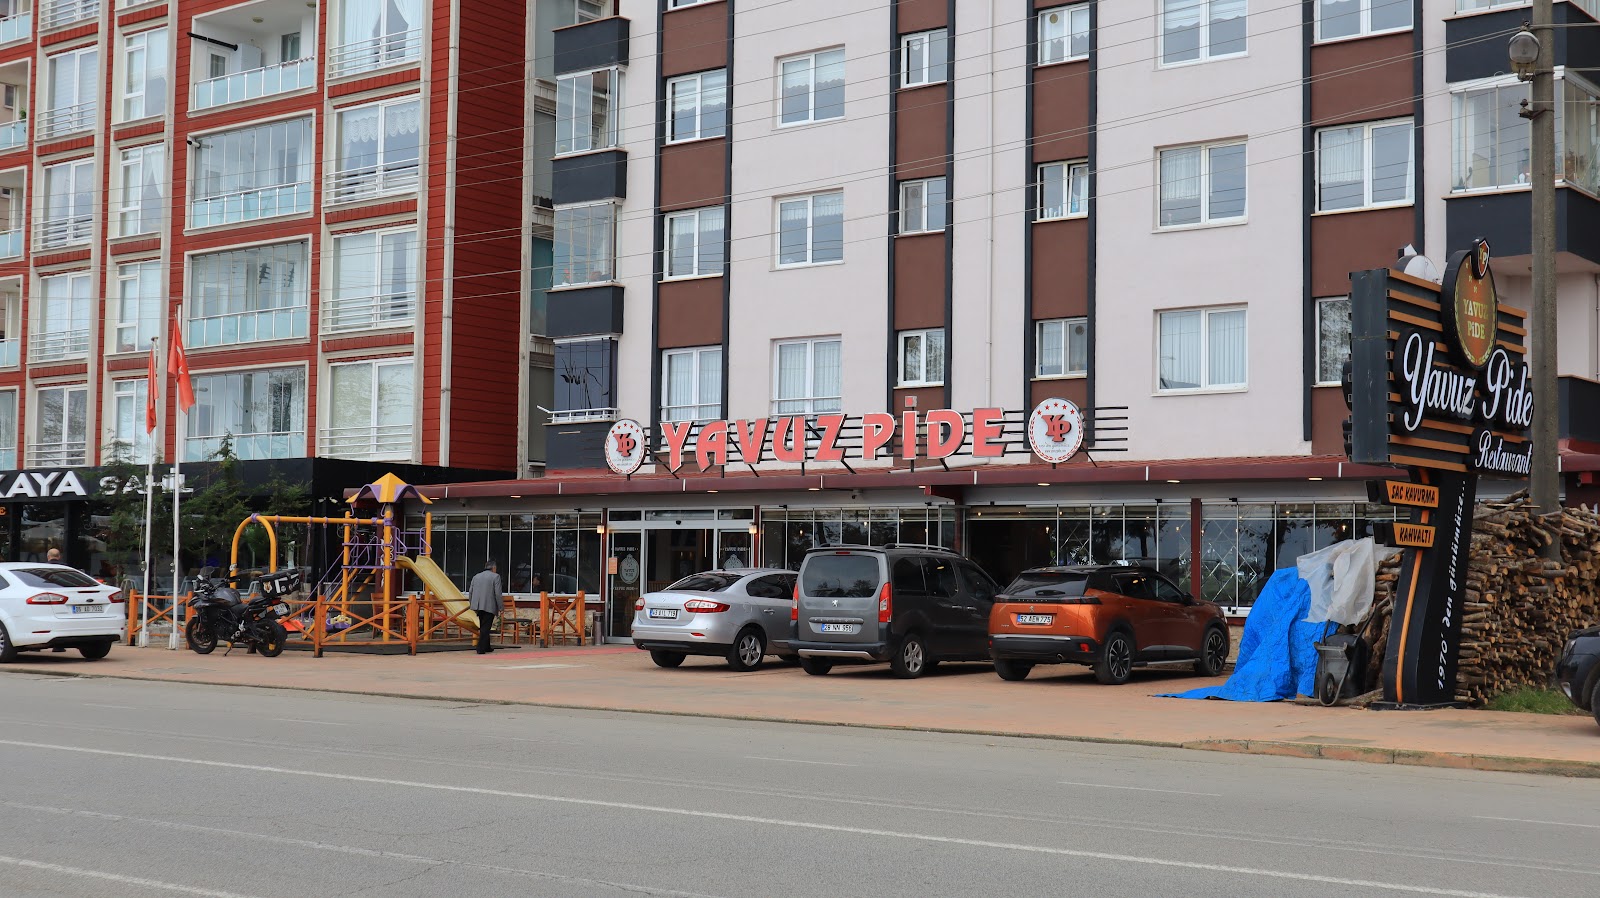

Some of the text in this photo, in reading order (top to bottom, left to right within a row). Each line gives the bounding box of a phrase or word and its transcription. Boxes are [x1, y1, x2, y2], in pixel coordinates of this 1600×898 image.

[1463, 298, 1489, 320] YAVUZ
[1403, 332, 1534, 432] Yavuz Pide
[660, 414, 846, 473] YAVUZ
[1475, 430, 1533, 475] Restaurant
[1391, 485, 1436, 504] SAC KAVURMA
[1400, 527, 1432, 544] KAHVALTI
